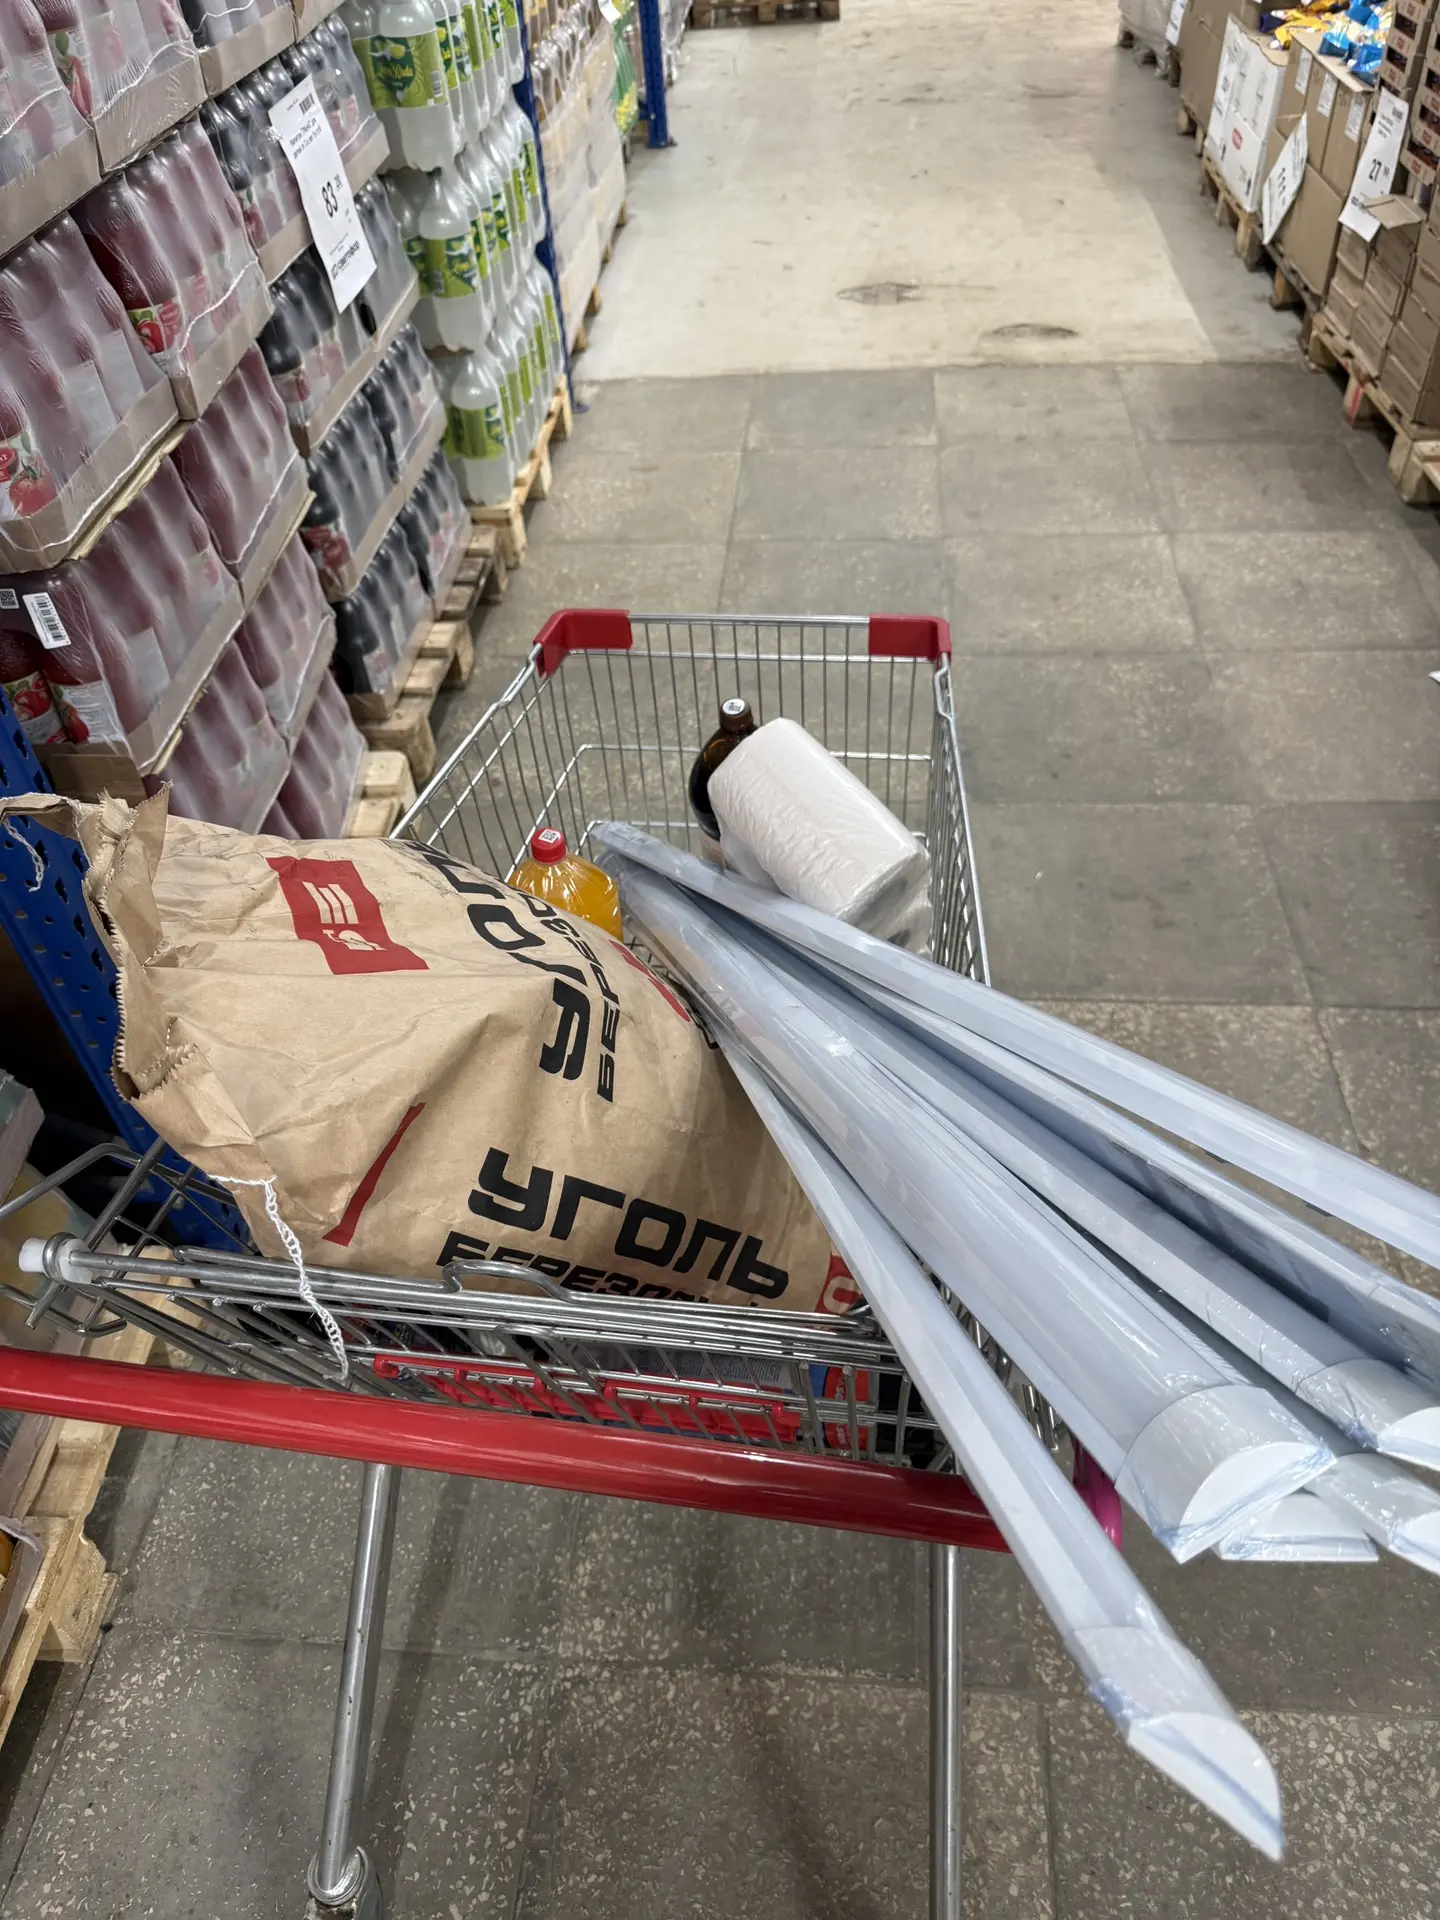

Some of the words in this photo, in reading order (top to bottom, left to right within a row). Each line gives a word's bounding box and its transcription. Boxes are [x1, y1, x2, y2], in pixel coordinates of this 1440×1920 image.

[1368, 157, 1382, 182] 27
[321, 181, 338, 218] 83
[468, 1147, 789, 1299] УГОЛЬ
